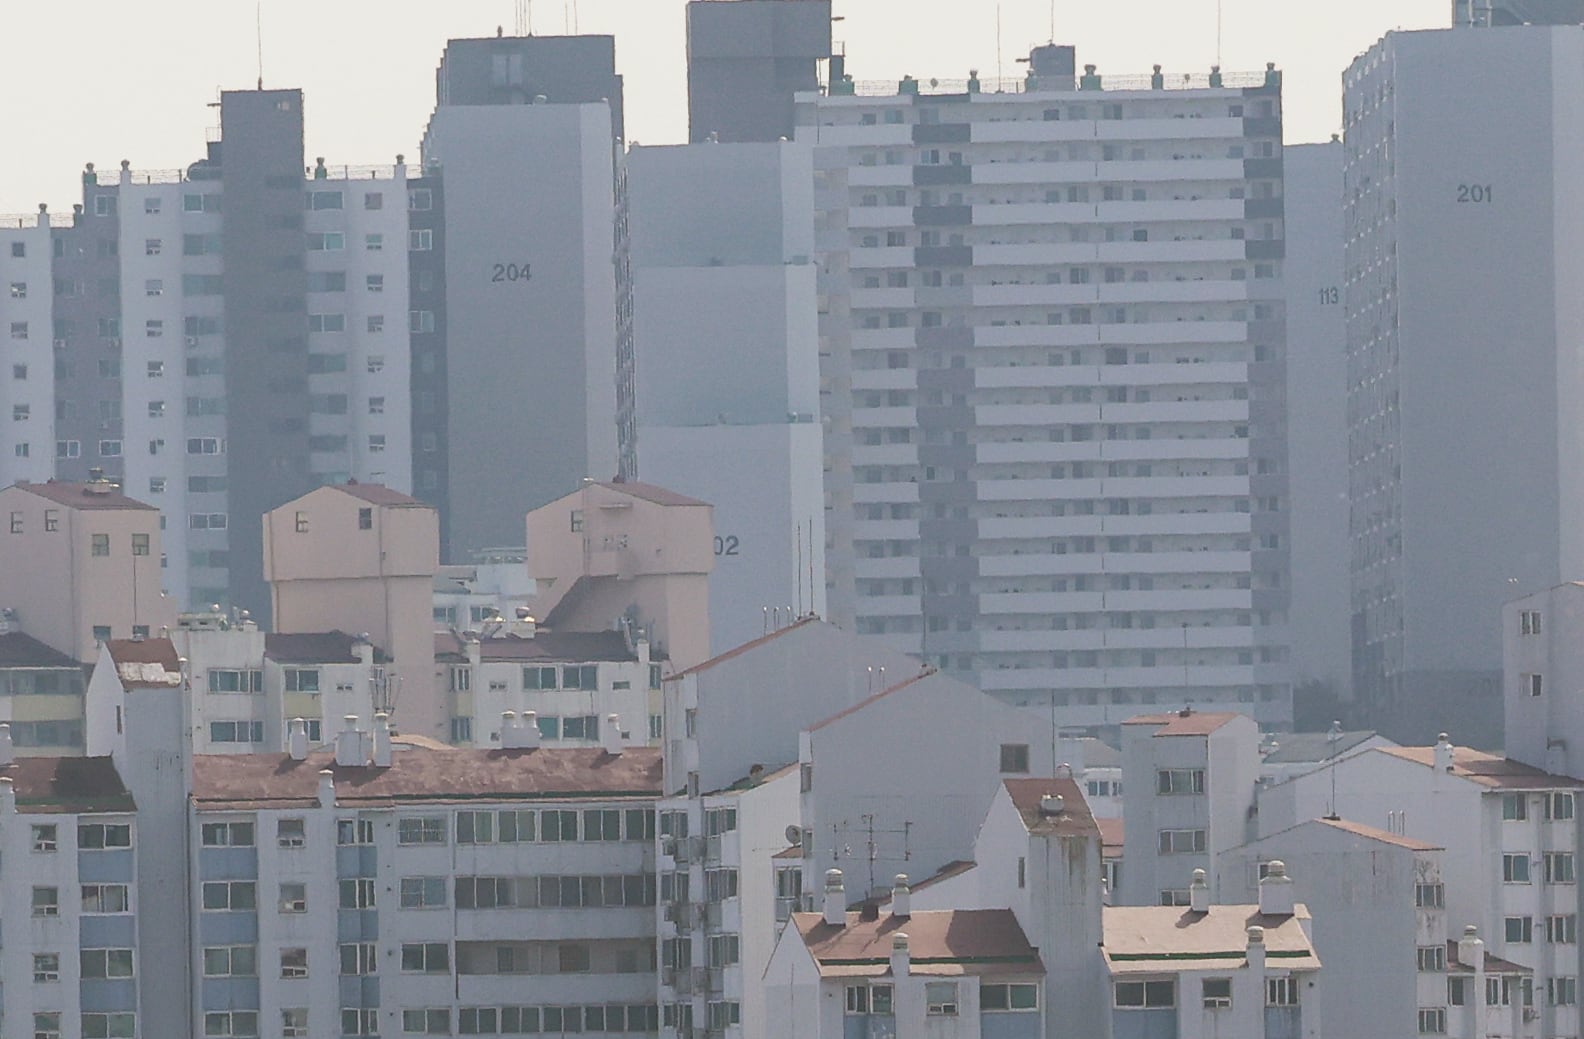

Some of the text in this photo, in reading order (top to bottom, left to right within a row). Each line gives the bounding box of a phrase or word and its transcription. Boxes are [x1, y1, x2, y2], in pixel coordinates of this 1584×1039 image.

[1457, 184, 1493, 203] 201
[491, 263, 532, 282] 204
[713, 535, 740, 555] 02
